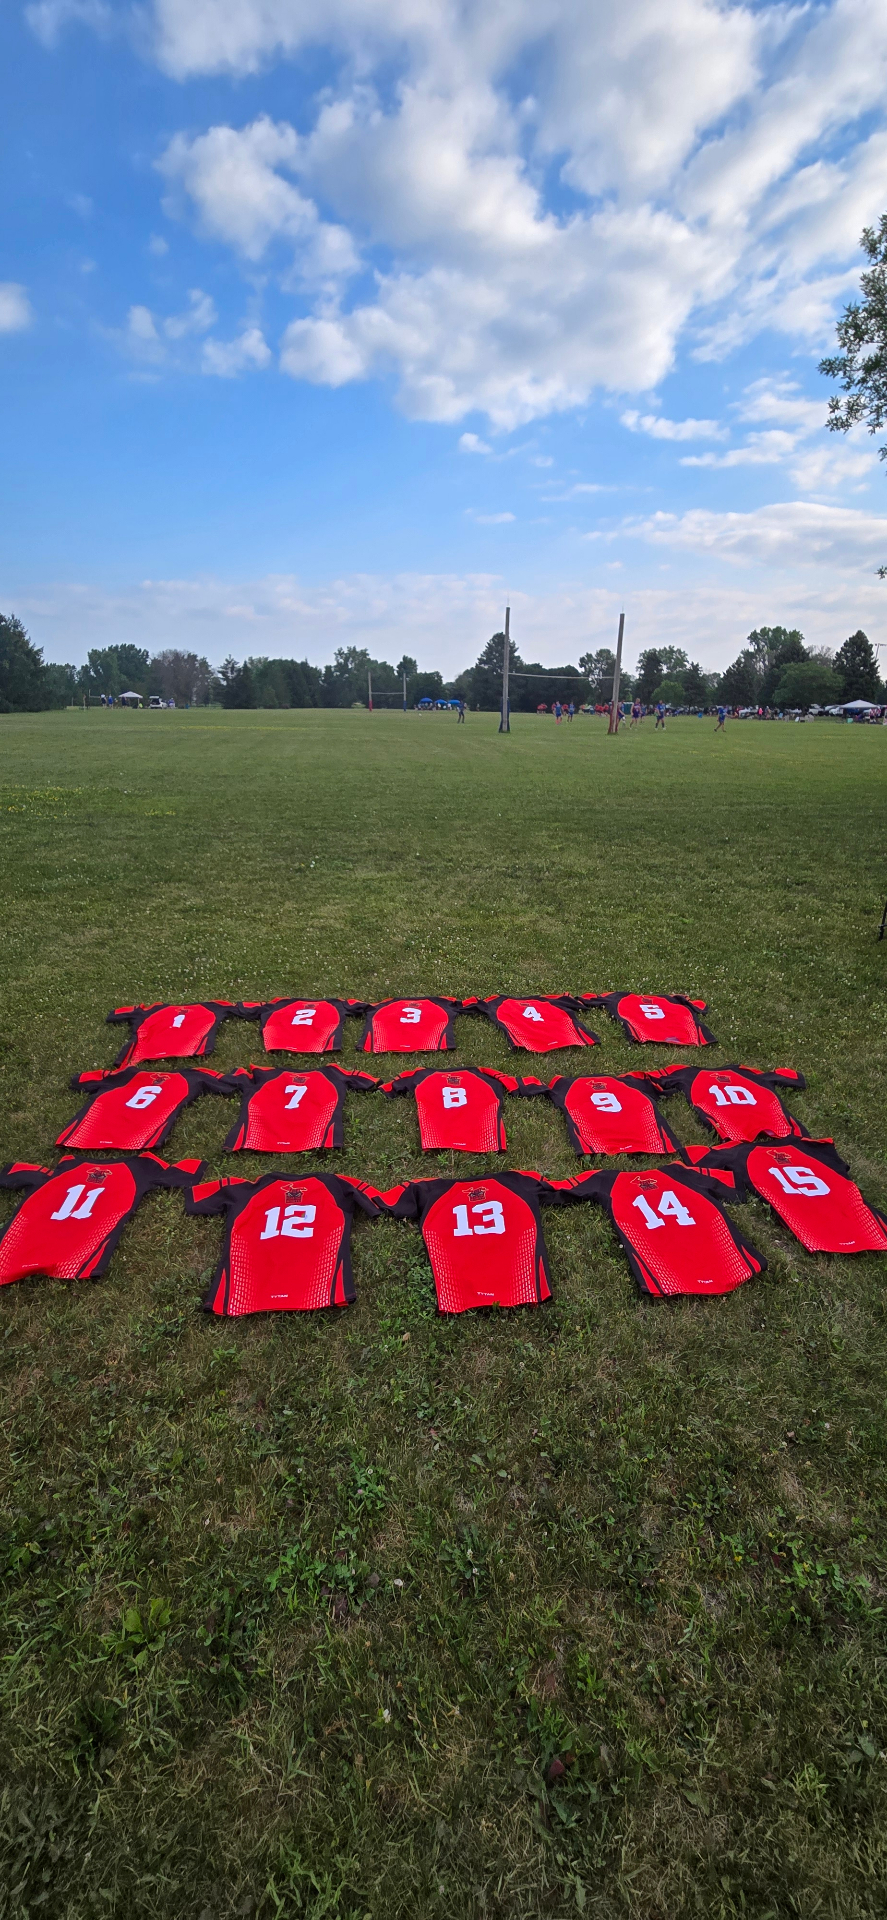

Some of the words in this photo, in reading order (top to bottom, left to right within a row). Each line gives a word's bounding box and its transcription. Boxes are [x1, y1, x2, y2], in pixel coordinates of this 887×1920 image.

[171, 1015, 185, 1028] 1
[291, 1008, 317, 1026] 2
[400, 1007, 422, 1024] 3
[522, 1006, 545, 1022] 4
[639, 1004, 666, 1020] 5
[125, 1085, 163, 1109] 6
[284, 1084, 308, 1109] 7
[442, 1086, 468, 1109] 8
[590, 1092, 623, 1113] 9
[708, 1084, 758, 1106] 10
[768, 1166, 831, 1197] 15
[50, 1184, 106, 1221] 11
[632, 1190, 697, 1230] 14
[260, 1204, 317, 1240] 12
[452, 1200, 506, 1237] 13
